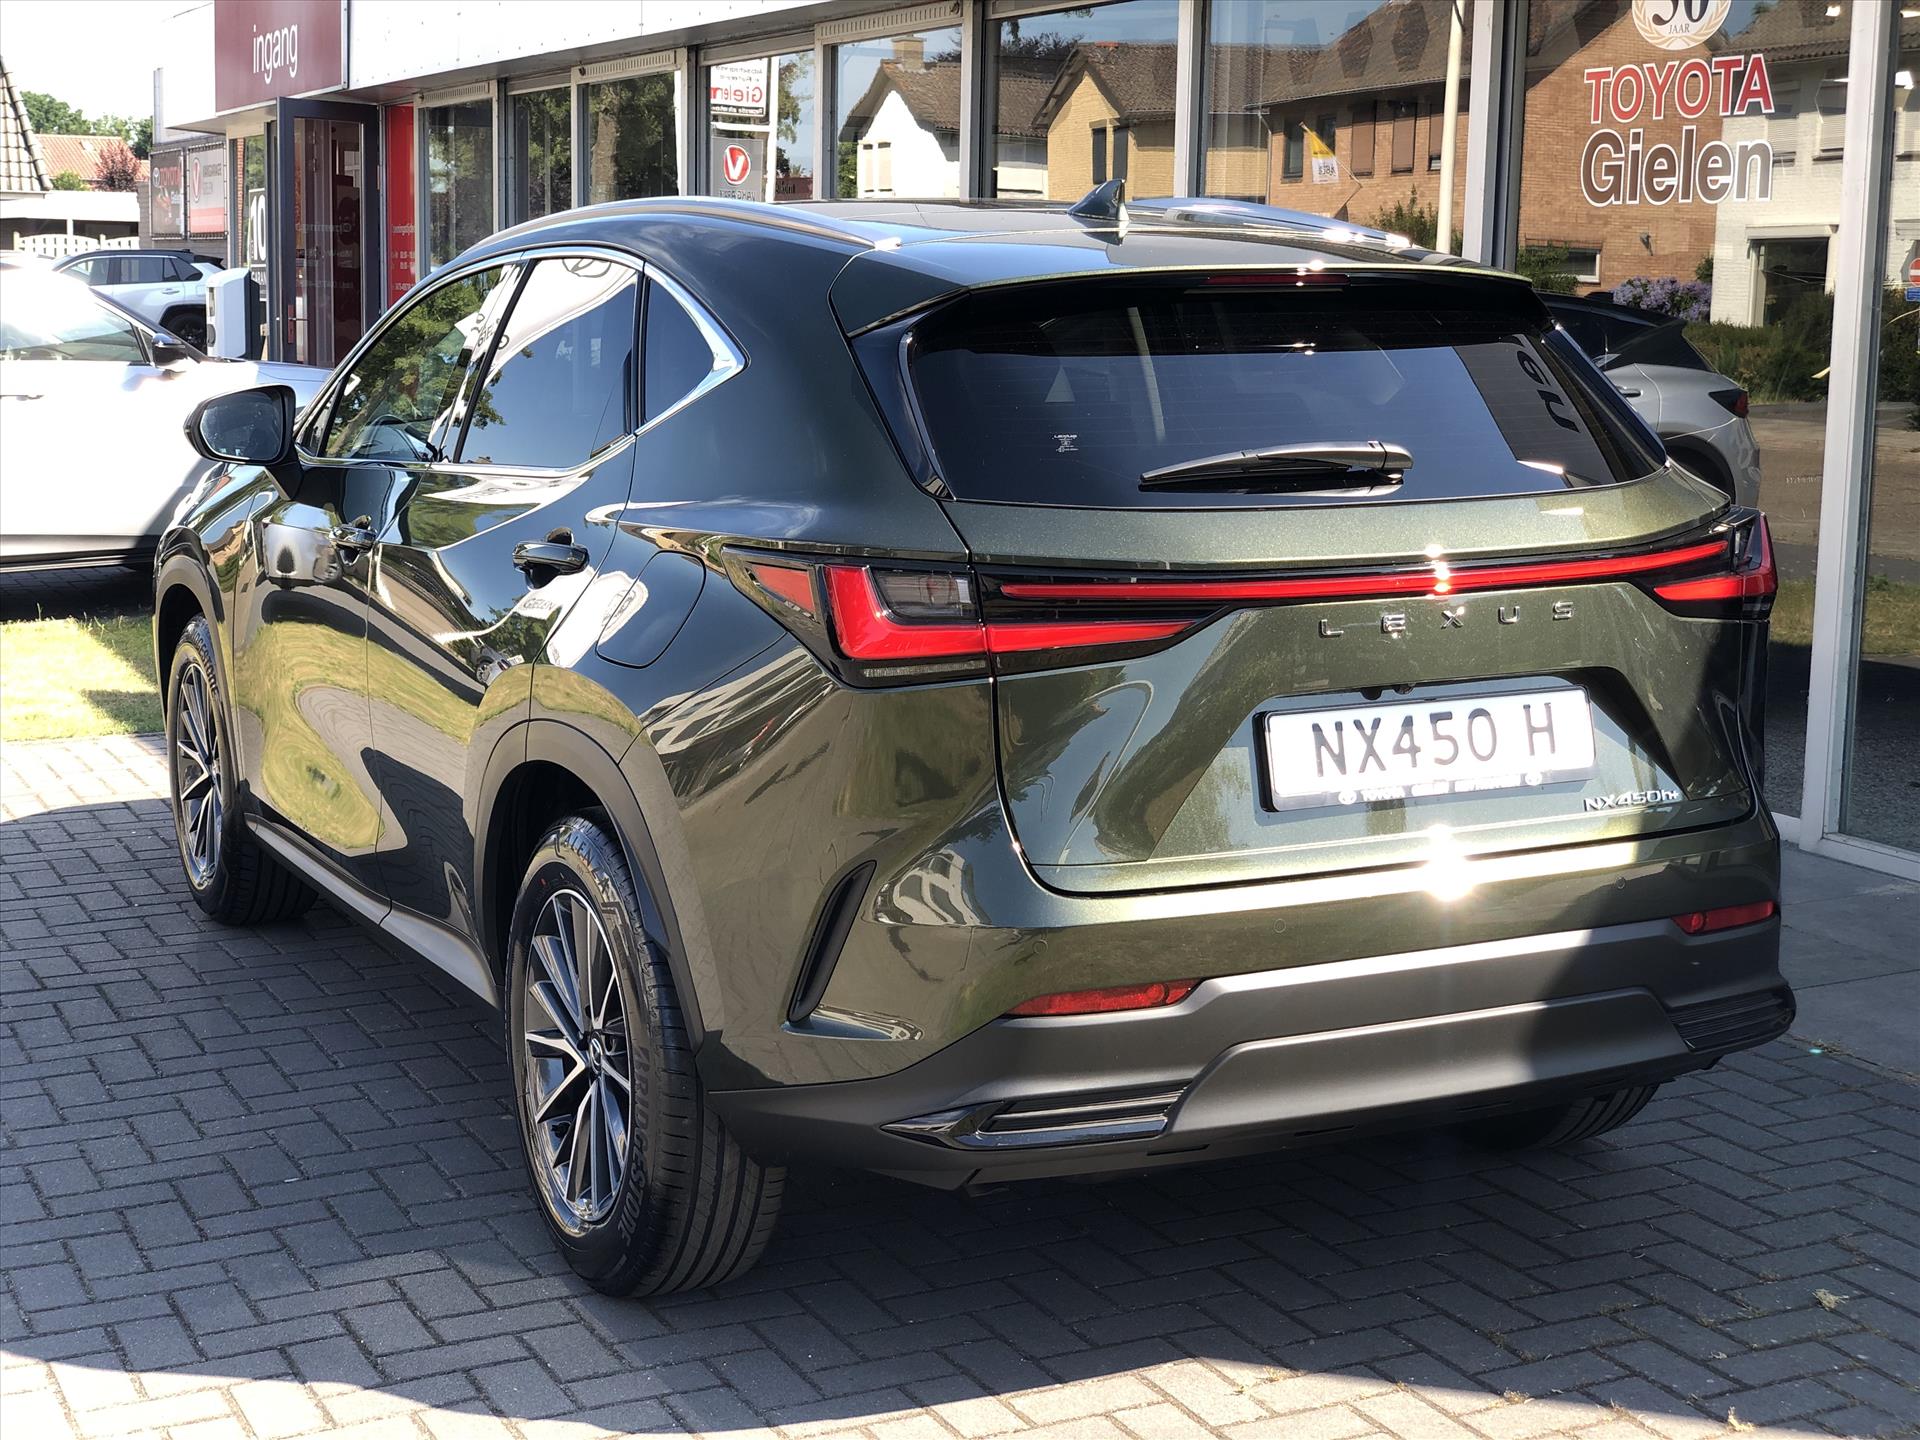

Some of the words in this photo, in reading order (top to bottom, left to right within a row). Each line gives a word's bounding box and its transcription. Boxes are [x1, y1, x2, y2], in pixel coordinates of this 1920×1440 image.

[253, 23, 298, 85] ingang
[1669, 23, 1690, 34] JAAR
[1584, 54, 1775, 124] TOYOTA
[1581, 125, 1774, 207] Gielen
[1318, 600, 1575, 638] LEXUS
[1311, 707, 1498, 778] NX450
[1523, 702, 1556, 756] H
